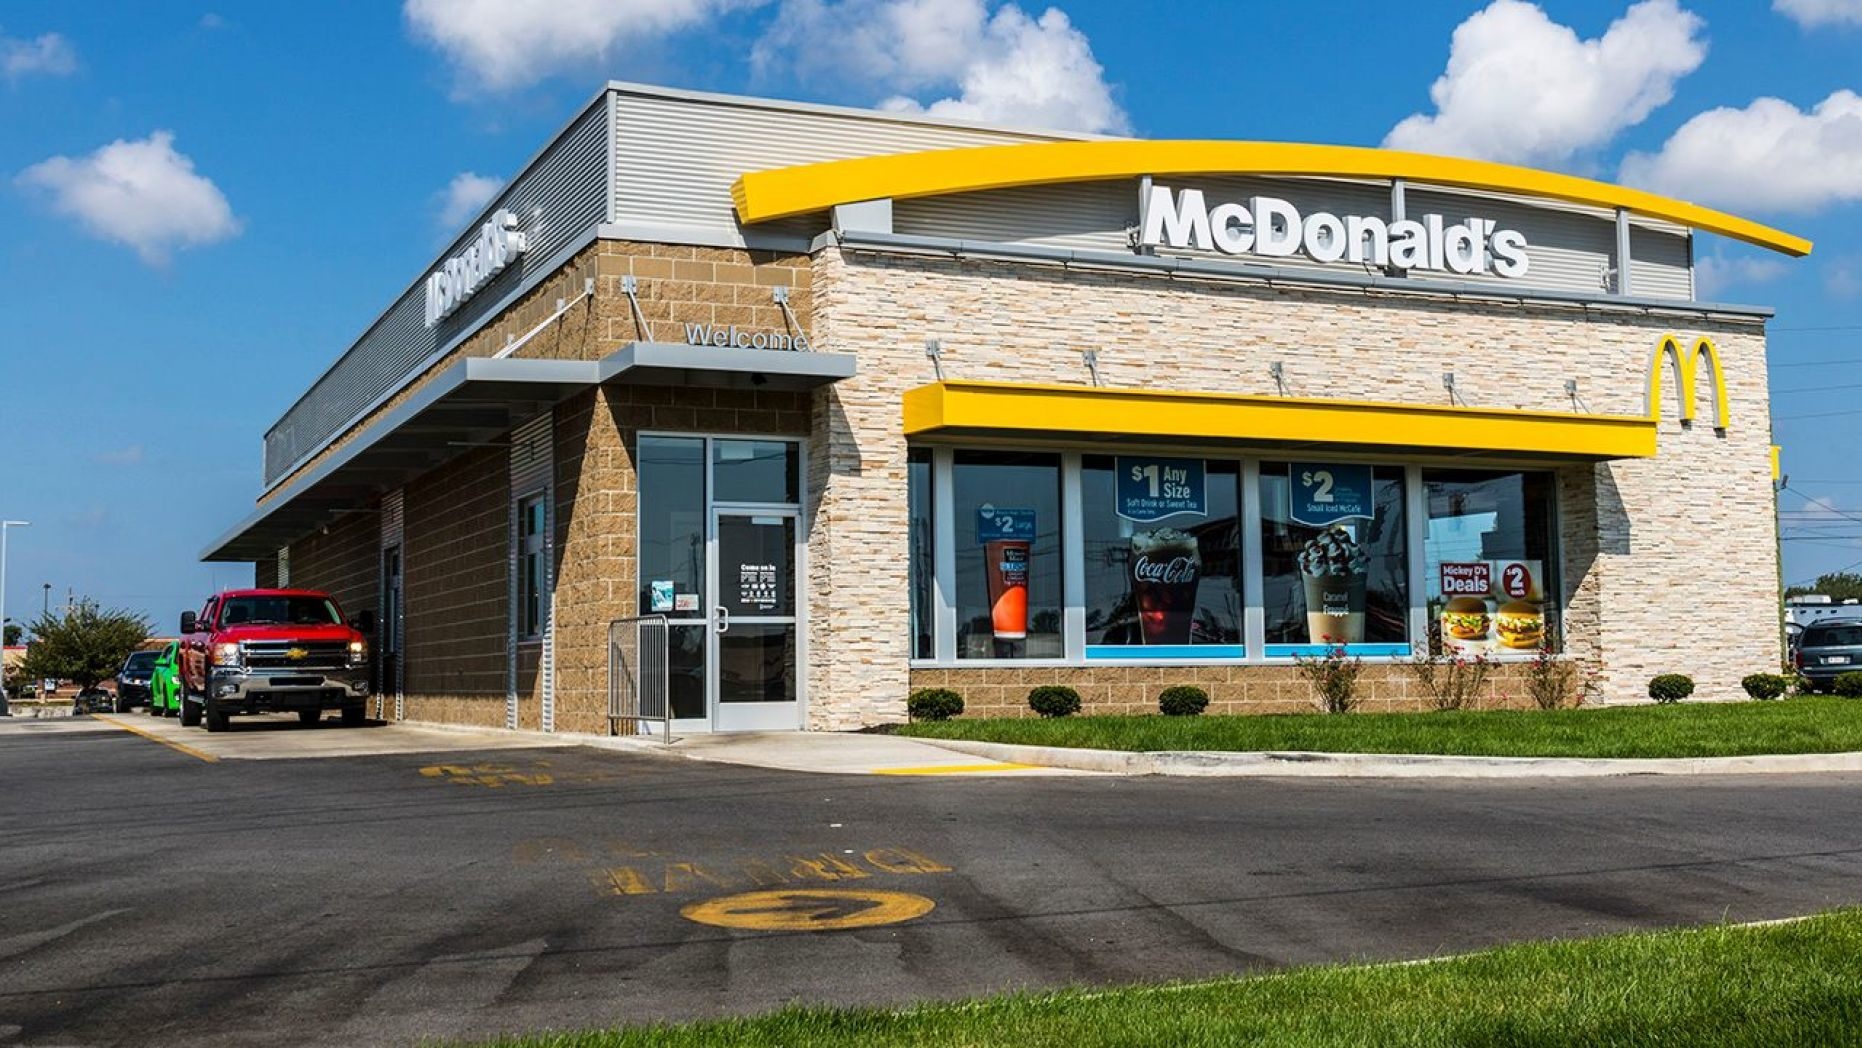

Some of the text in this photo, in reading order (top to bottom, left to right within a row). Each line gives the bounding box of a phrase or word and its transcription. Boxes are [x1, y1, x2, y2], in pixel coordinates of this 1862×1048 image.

[1143, 185, 1529, 278] McDonald's
[685, 322, 809, 351] Welcome
[1131, 465, 1187, 498] $1 Any
[1164, 483, 1190, 499] Size
[1302, 471, 1334, 503] $2
[995, 516, 1014, 532] $2
[1443, 565, 1487, 577] Mickey D's
[1506, 567, 1524, 588] $2
[1443, 575, 1488, 592] Deals
